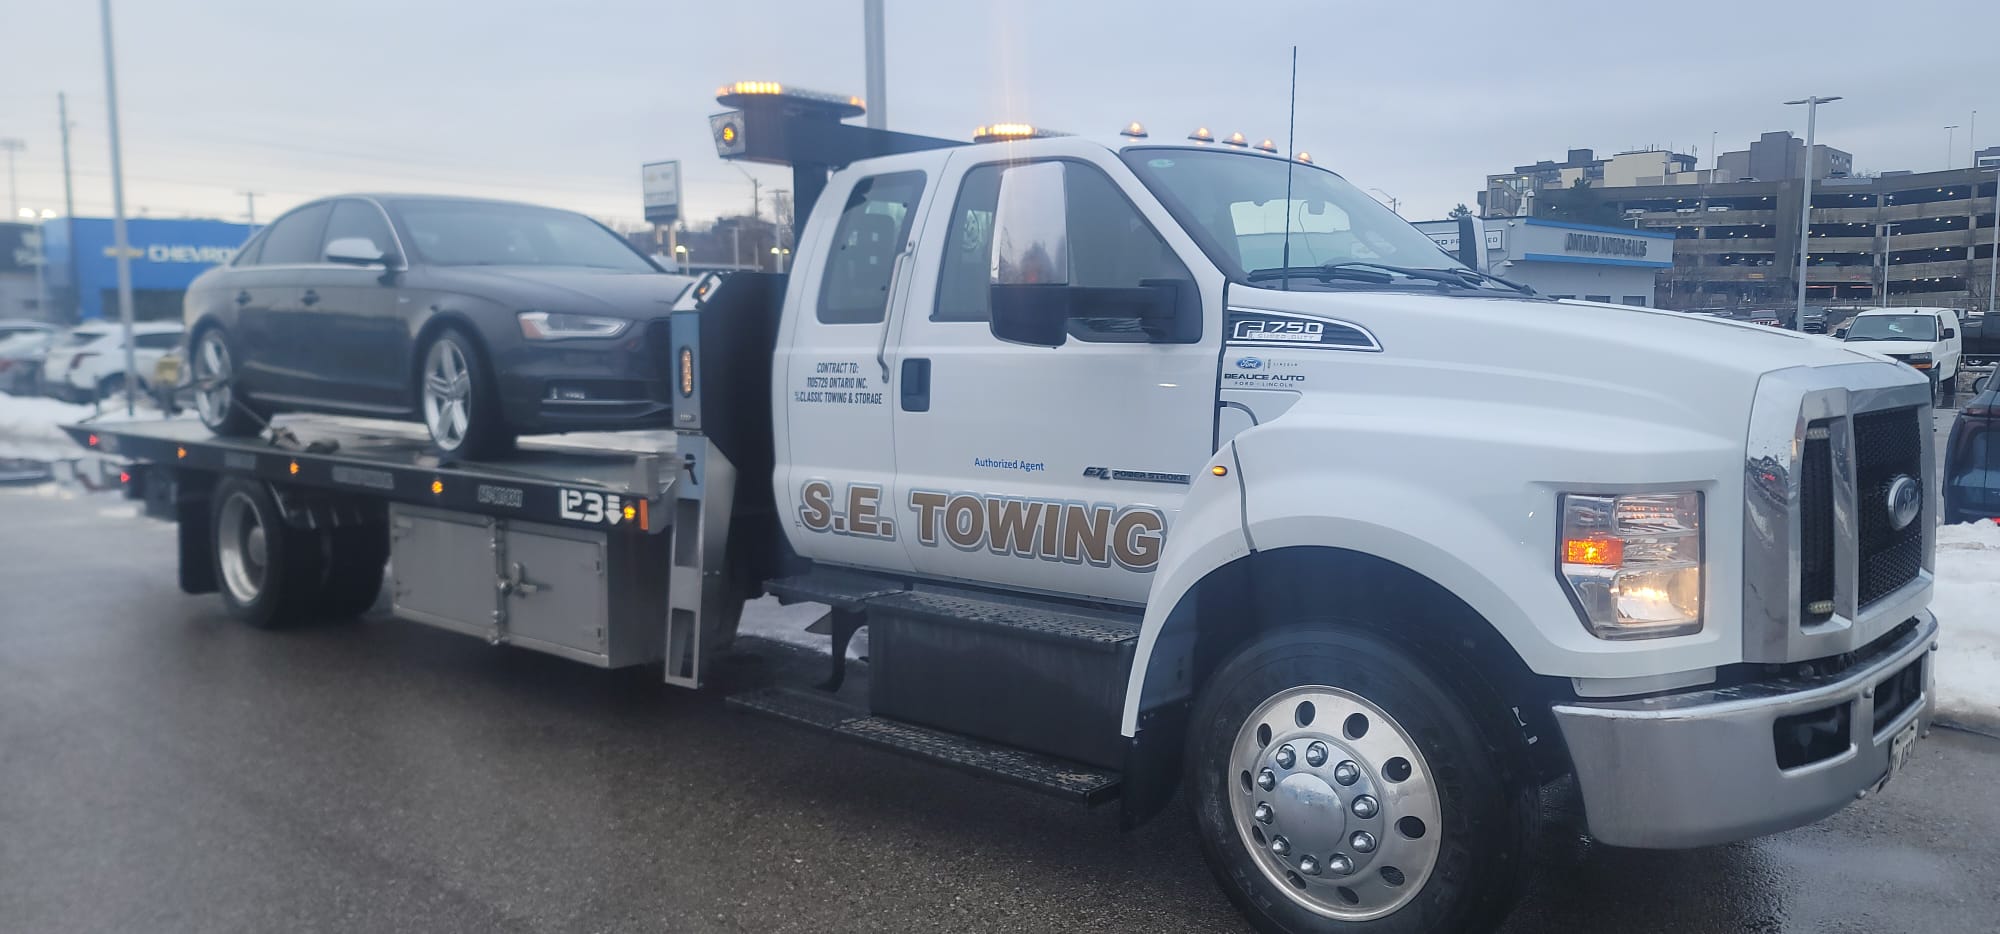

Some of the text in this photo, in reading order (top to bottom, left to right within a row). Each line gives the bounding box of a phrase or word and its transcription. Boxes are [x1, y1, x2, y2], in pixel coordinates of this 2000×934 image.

[816, 363, 859, 374] CONTRACT TO:
[829, 378, 855, 389] ONTARIO
[855, 378, 868, 390] INC.
[1271, 374, 1305, 382] AUTO
[800, 392, 823, 402] CLASSIC
[825, 392, 847, 404] TOWING
[854, 393, 883, 405] STORAGE
[974, 457, 1045, 472] Authorized Agent
[801, 481, 1166, 571] S.E. TOWING
